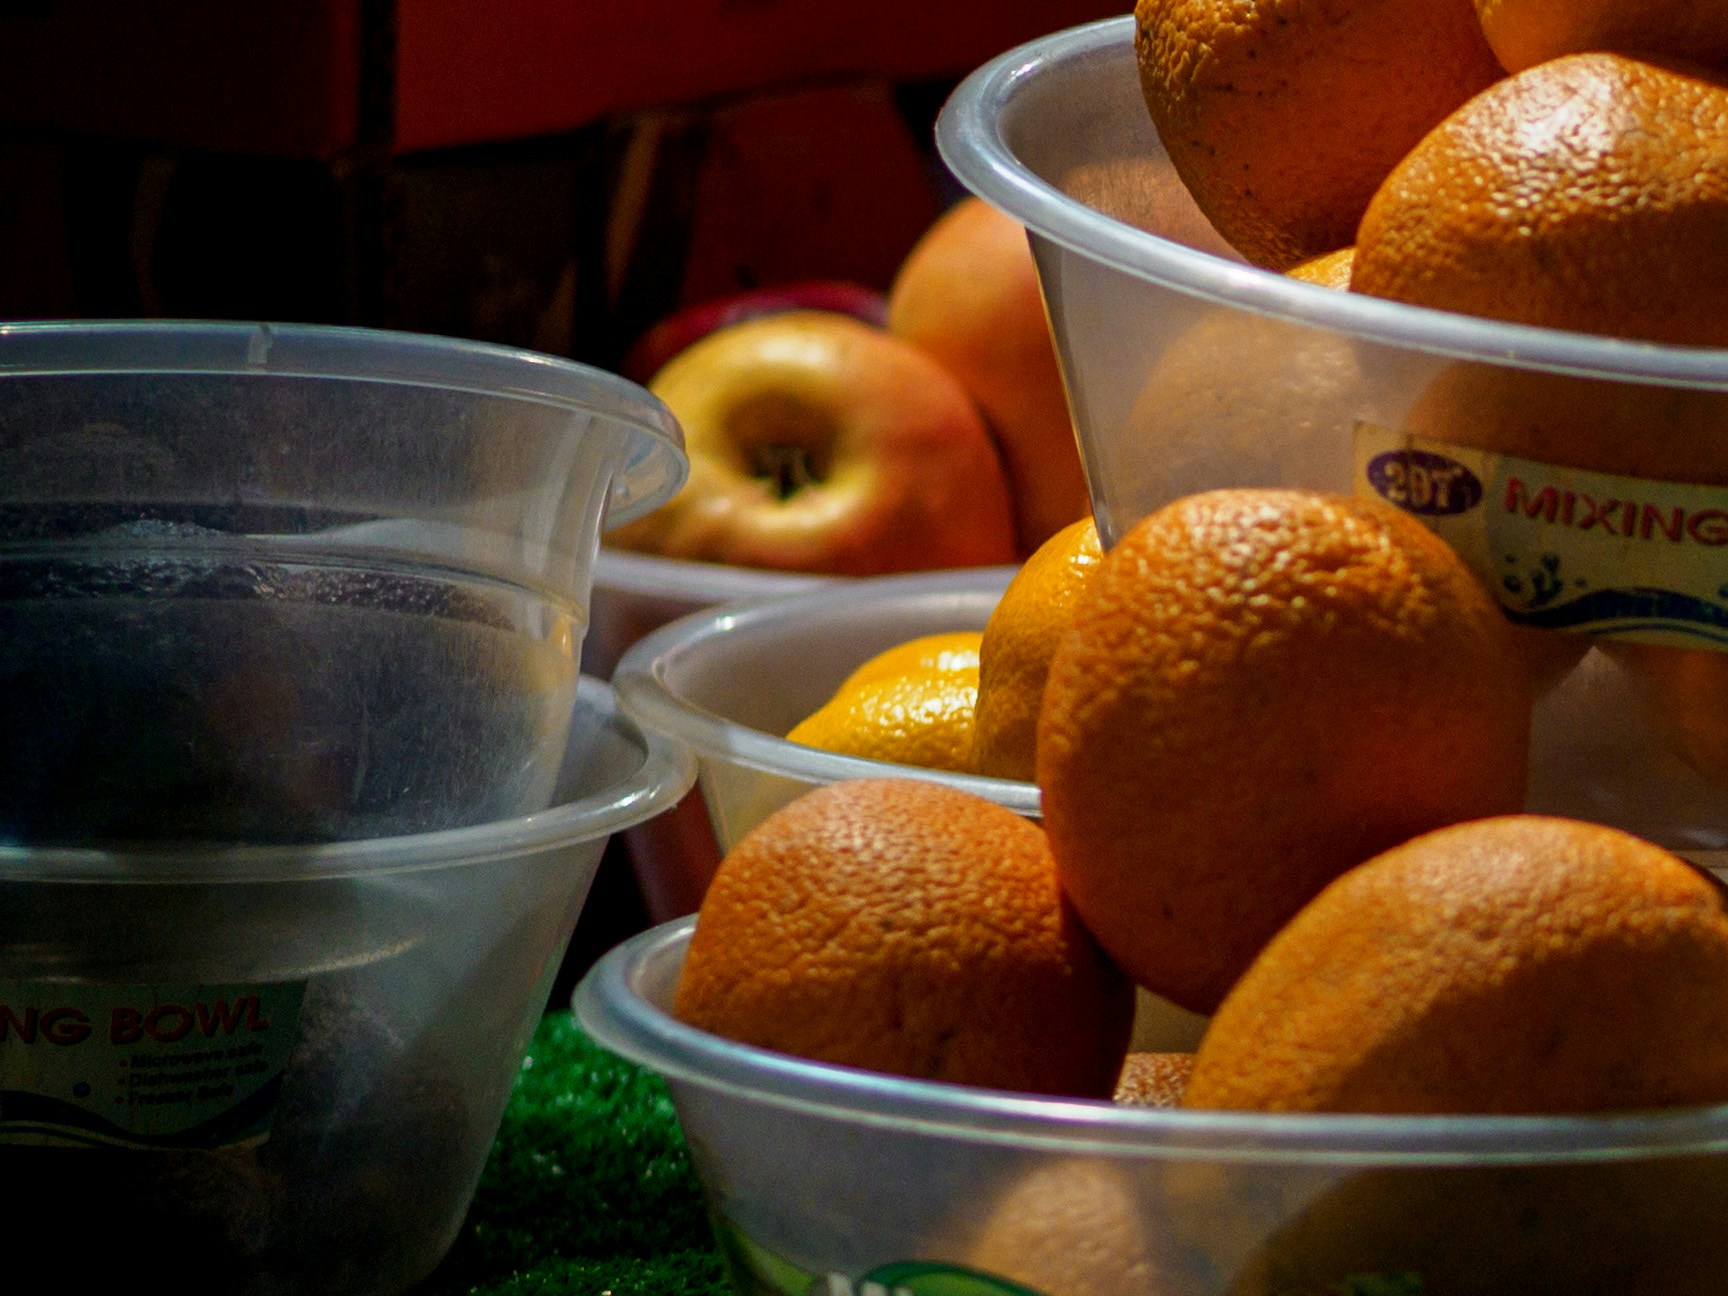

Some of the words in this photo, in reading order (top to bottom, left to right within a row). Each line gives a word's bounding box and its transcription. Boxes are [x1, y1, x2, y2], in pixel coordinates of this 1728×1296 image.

[110, 994, 270, 1044] BOWL
[130, 1050, 224, 1069] Microwave
[227, 1041, 263, 1059] safe
[129, 1066, 231, 1087] Dishwasher
[235, 1058, 270, 1076] safe
